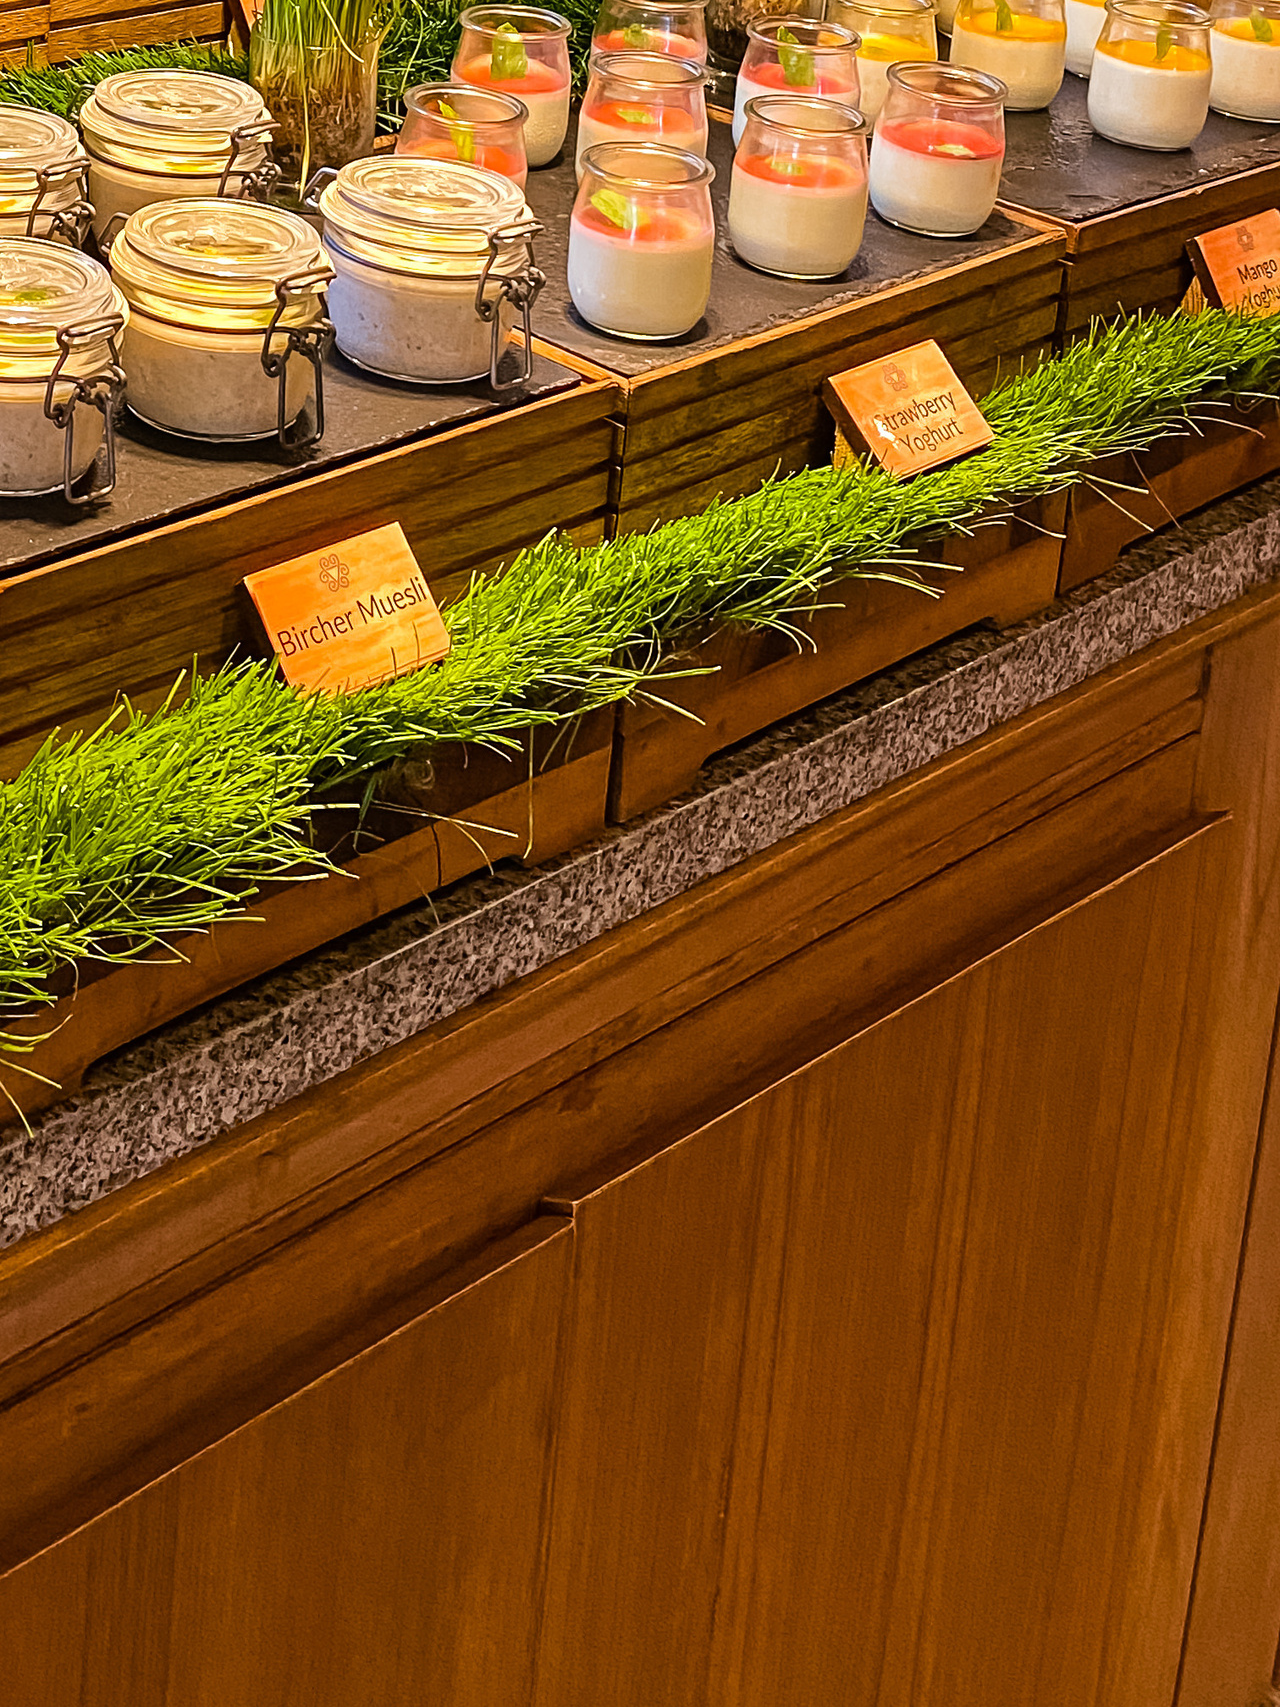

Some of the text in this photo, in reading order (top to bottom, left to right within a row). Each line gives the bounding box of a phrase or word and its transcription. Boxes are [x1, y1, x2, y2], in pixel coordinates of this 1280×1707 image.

[1236, 259, 1278, 285] Mango
[874, 391, 957, 432] Strawberry
[899, 417, 964, 455] Yoghurt
[277, 576, 427, 657] Bircher Muesli
